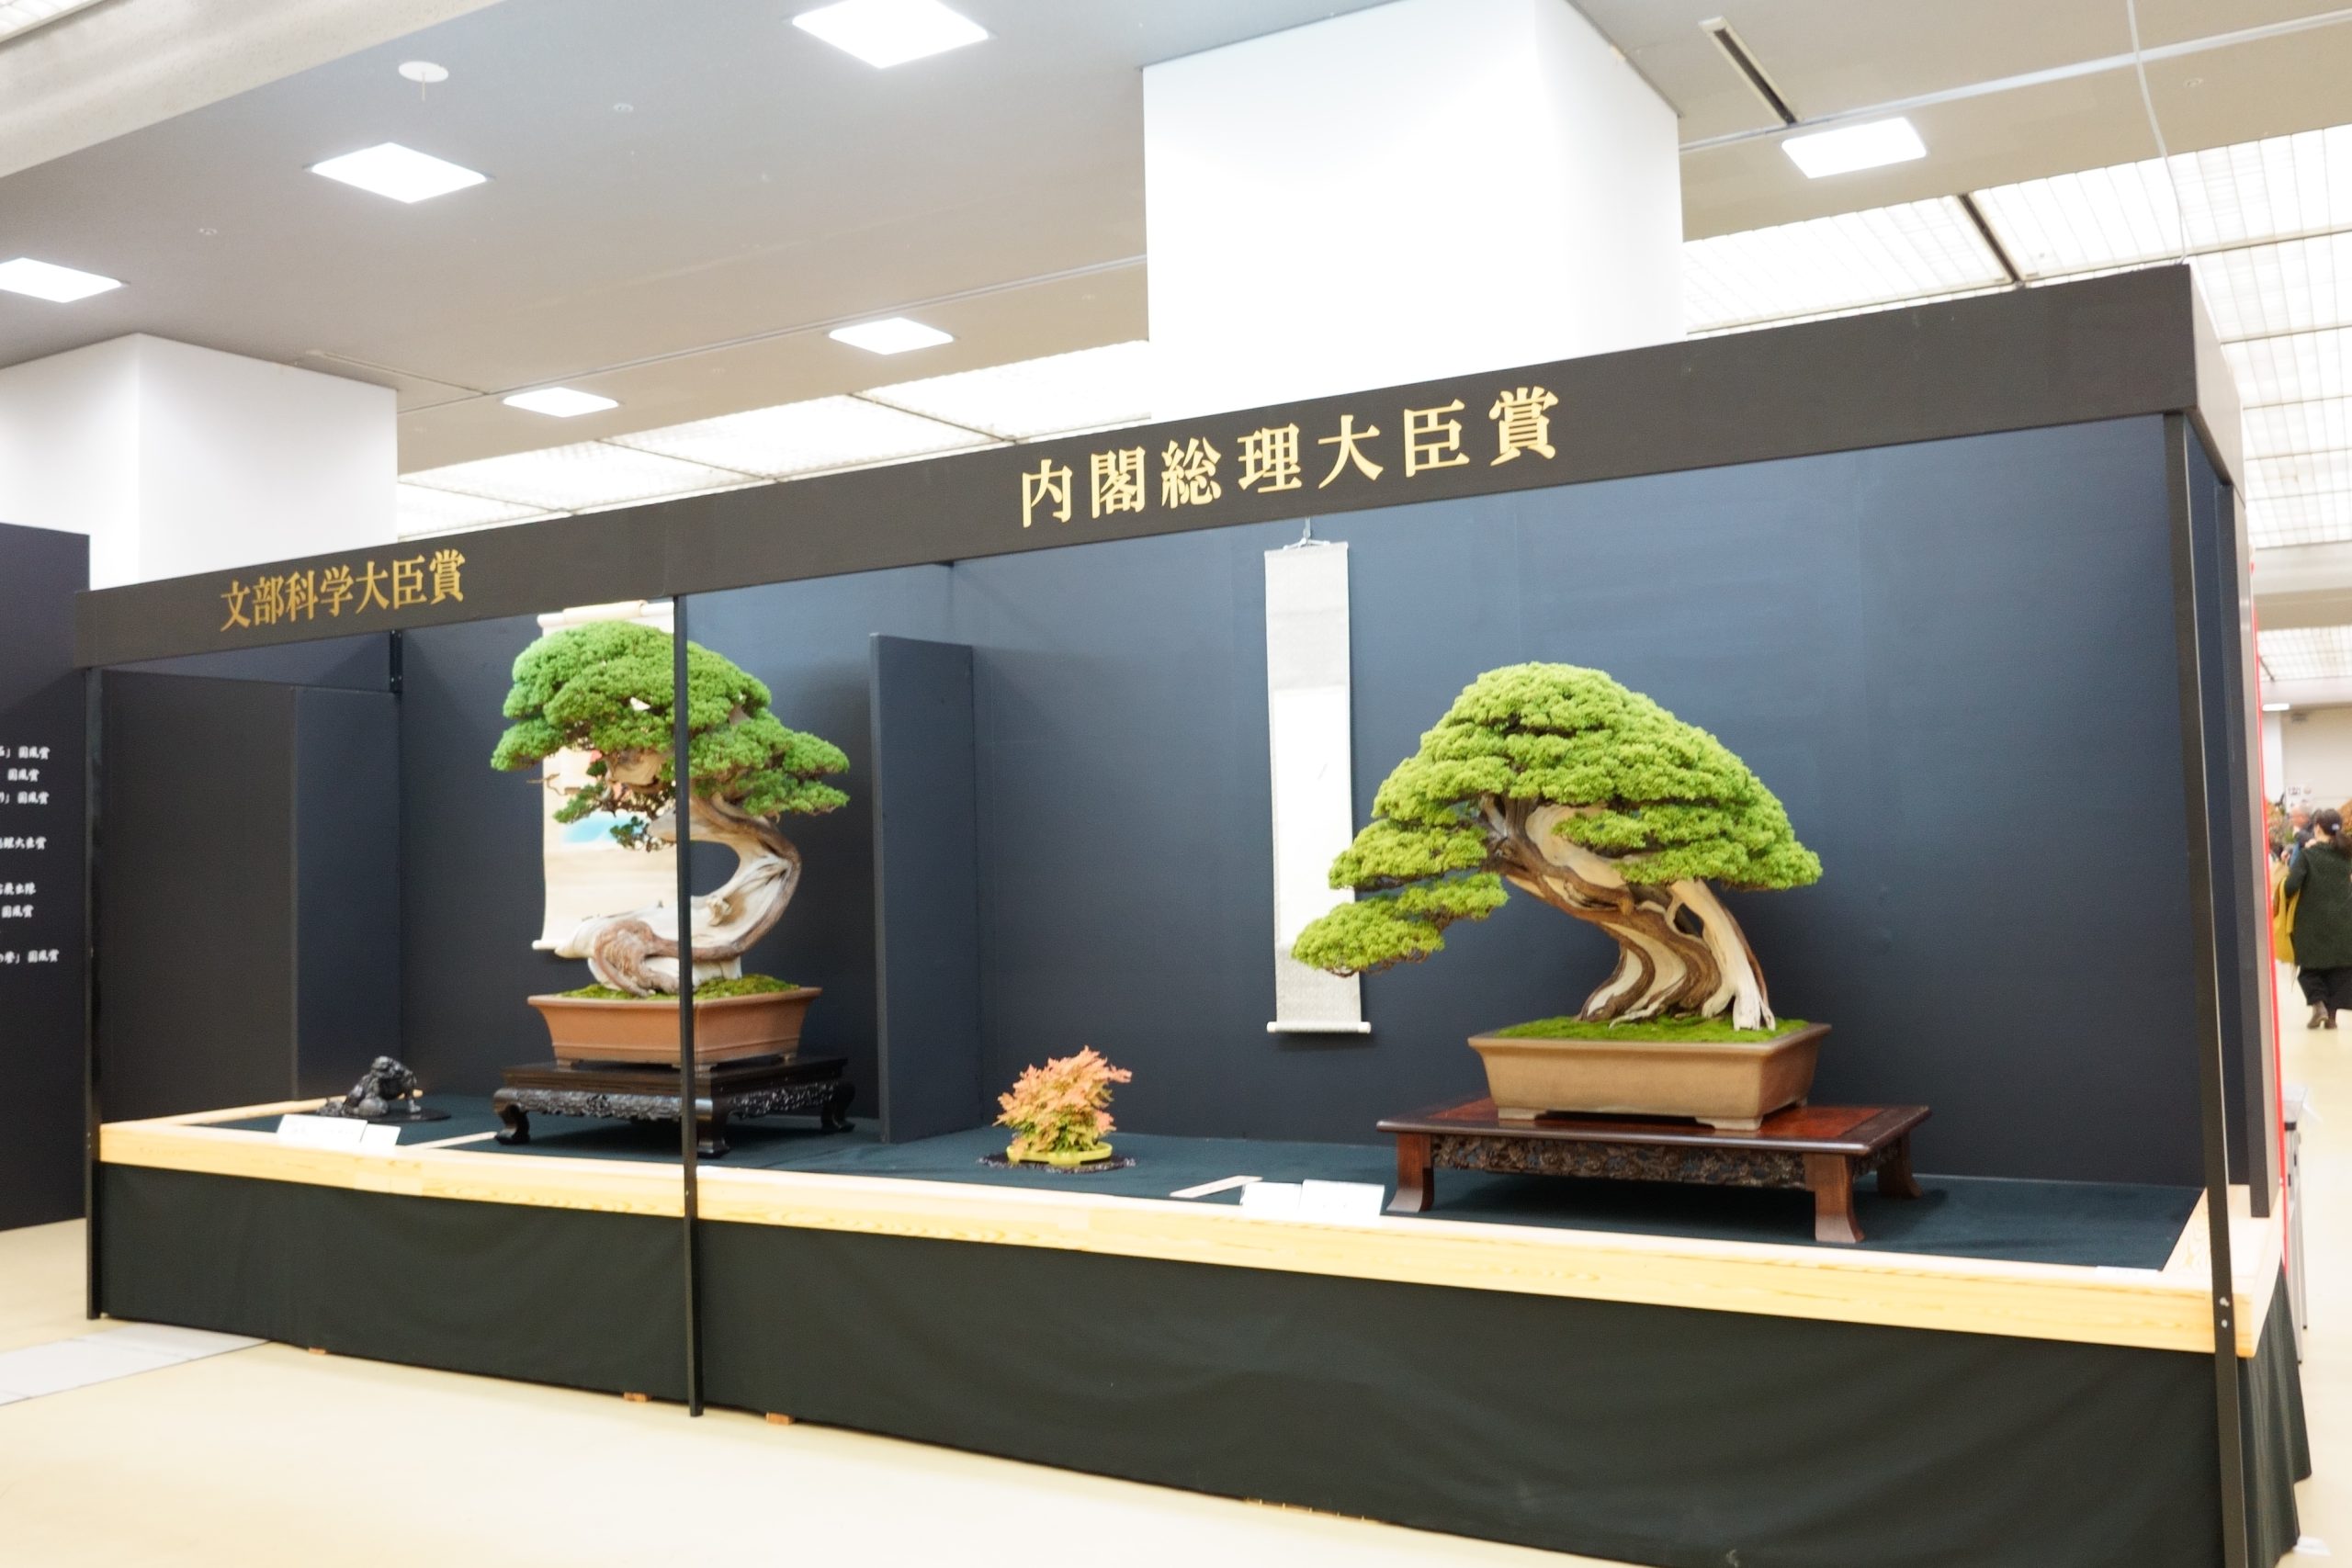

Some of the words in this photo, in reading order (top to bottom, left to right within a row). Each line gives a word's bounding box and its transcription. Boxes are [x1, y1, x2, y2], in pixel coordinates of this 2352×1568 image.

[1021, 386, 1559, 529] 内閣総理大臣賞
[220, 548, 466, 633] 文部科学大臣賞
